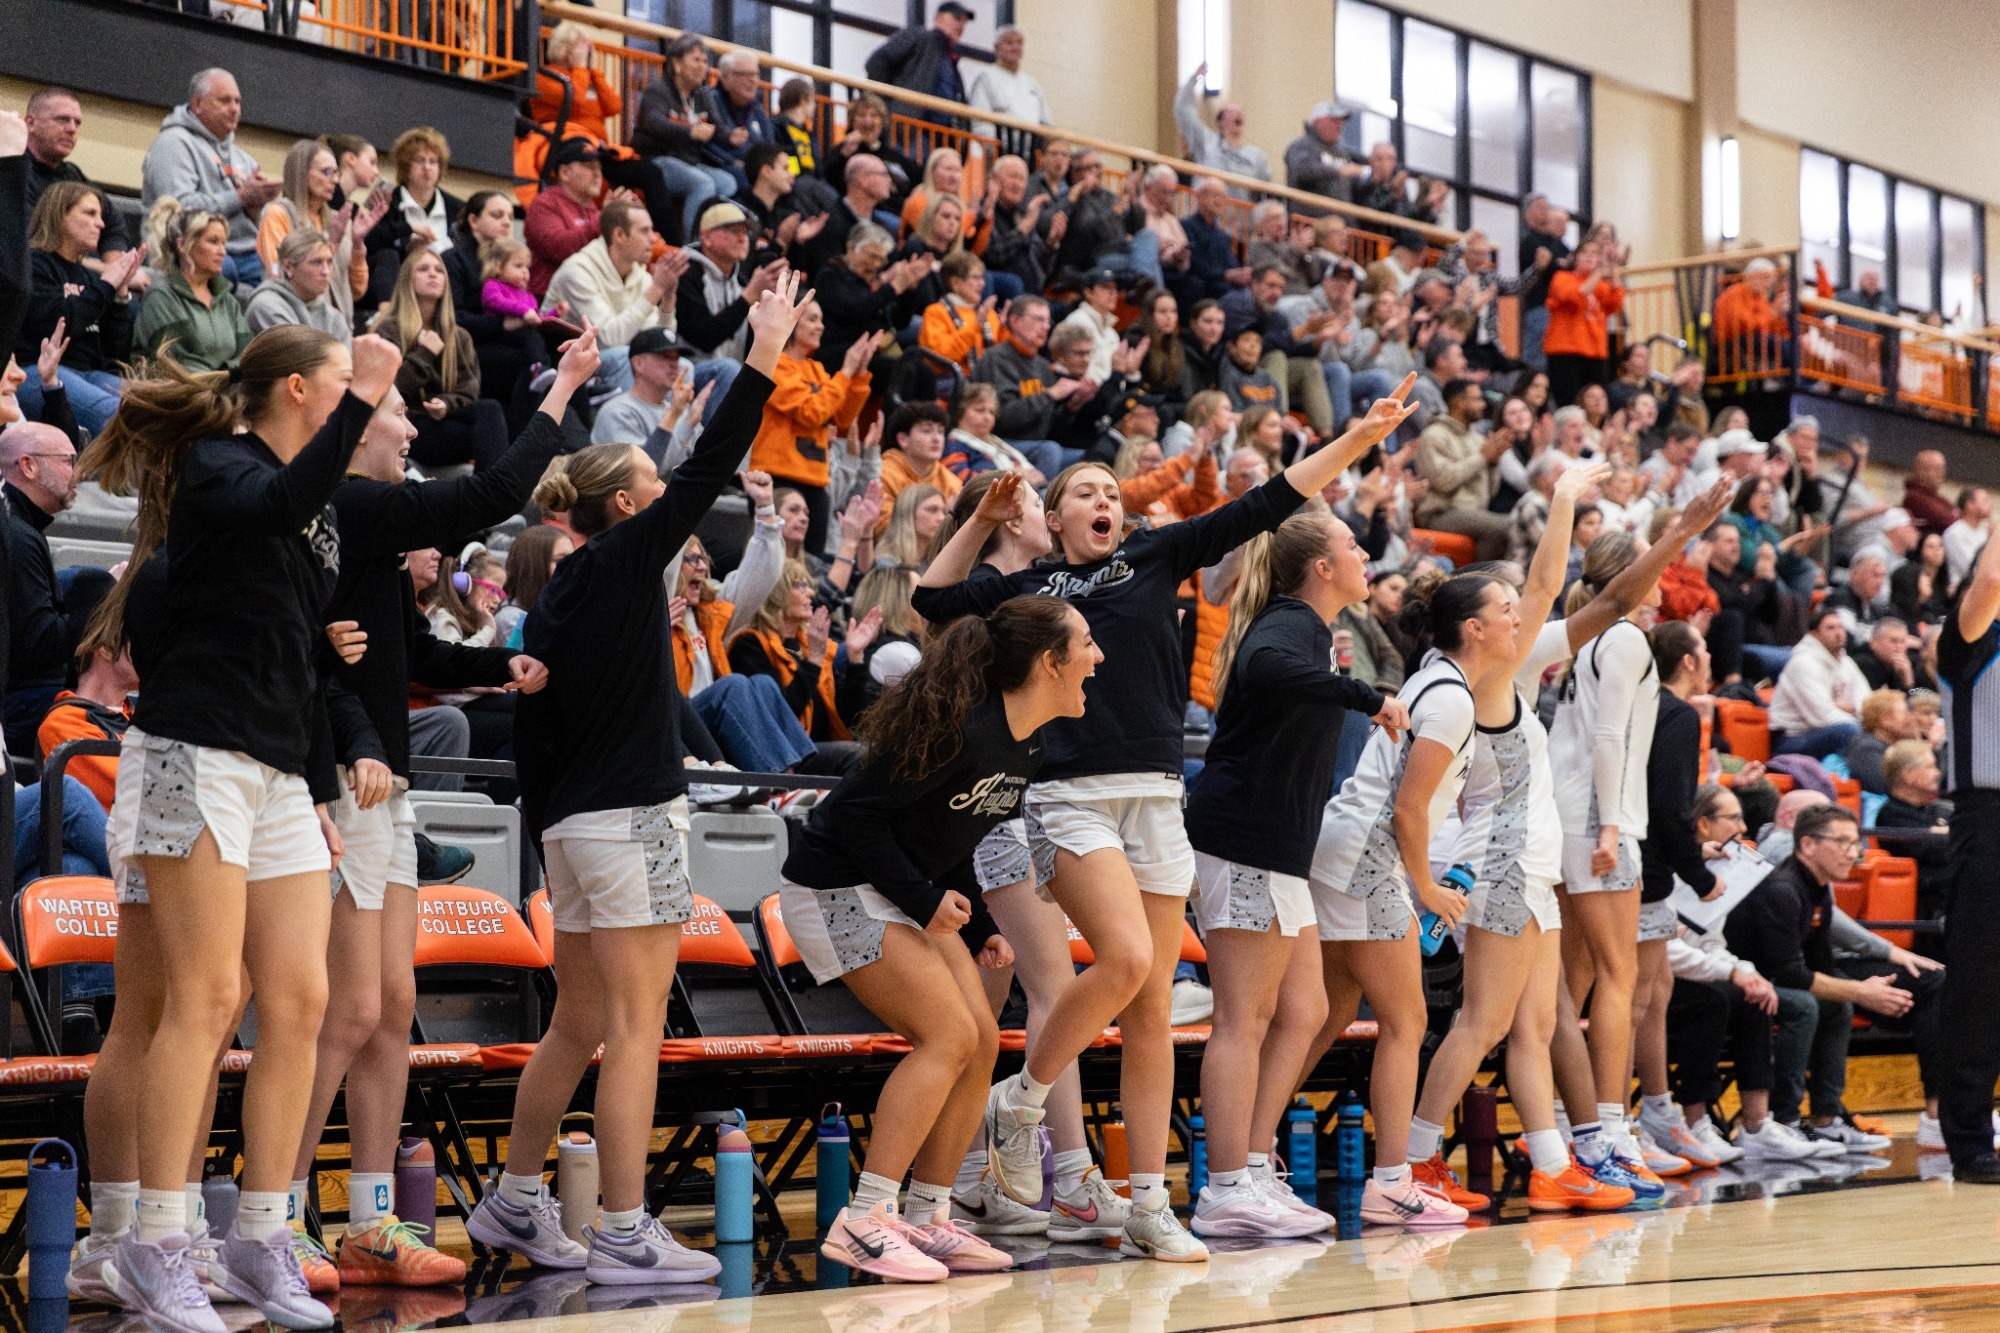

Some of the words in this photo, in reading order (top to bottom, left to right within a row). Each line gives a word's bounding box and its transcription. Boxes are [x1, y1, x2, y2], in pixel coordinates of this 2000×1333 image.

[36, 898, 119, 917] WARTBU
[417, 900, 509, 916] ARTBURG
[55, 917, 118, 938] COLLE
[421, 918, 505, 935] COLLEGE
[681, 920, 721, 936] LEGE
[702, 1040, 764, 1056] KNIGHTS
[796, 1038, 853, 1053] KNIGHTS
[408, 1050, 461, 1065] IGHTS
